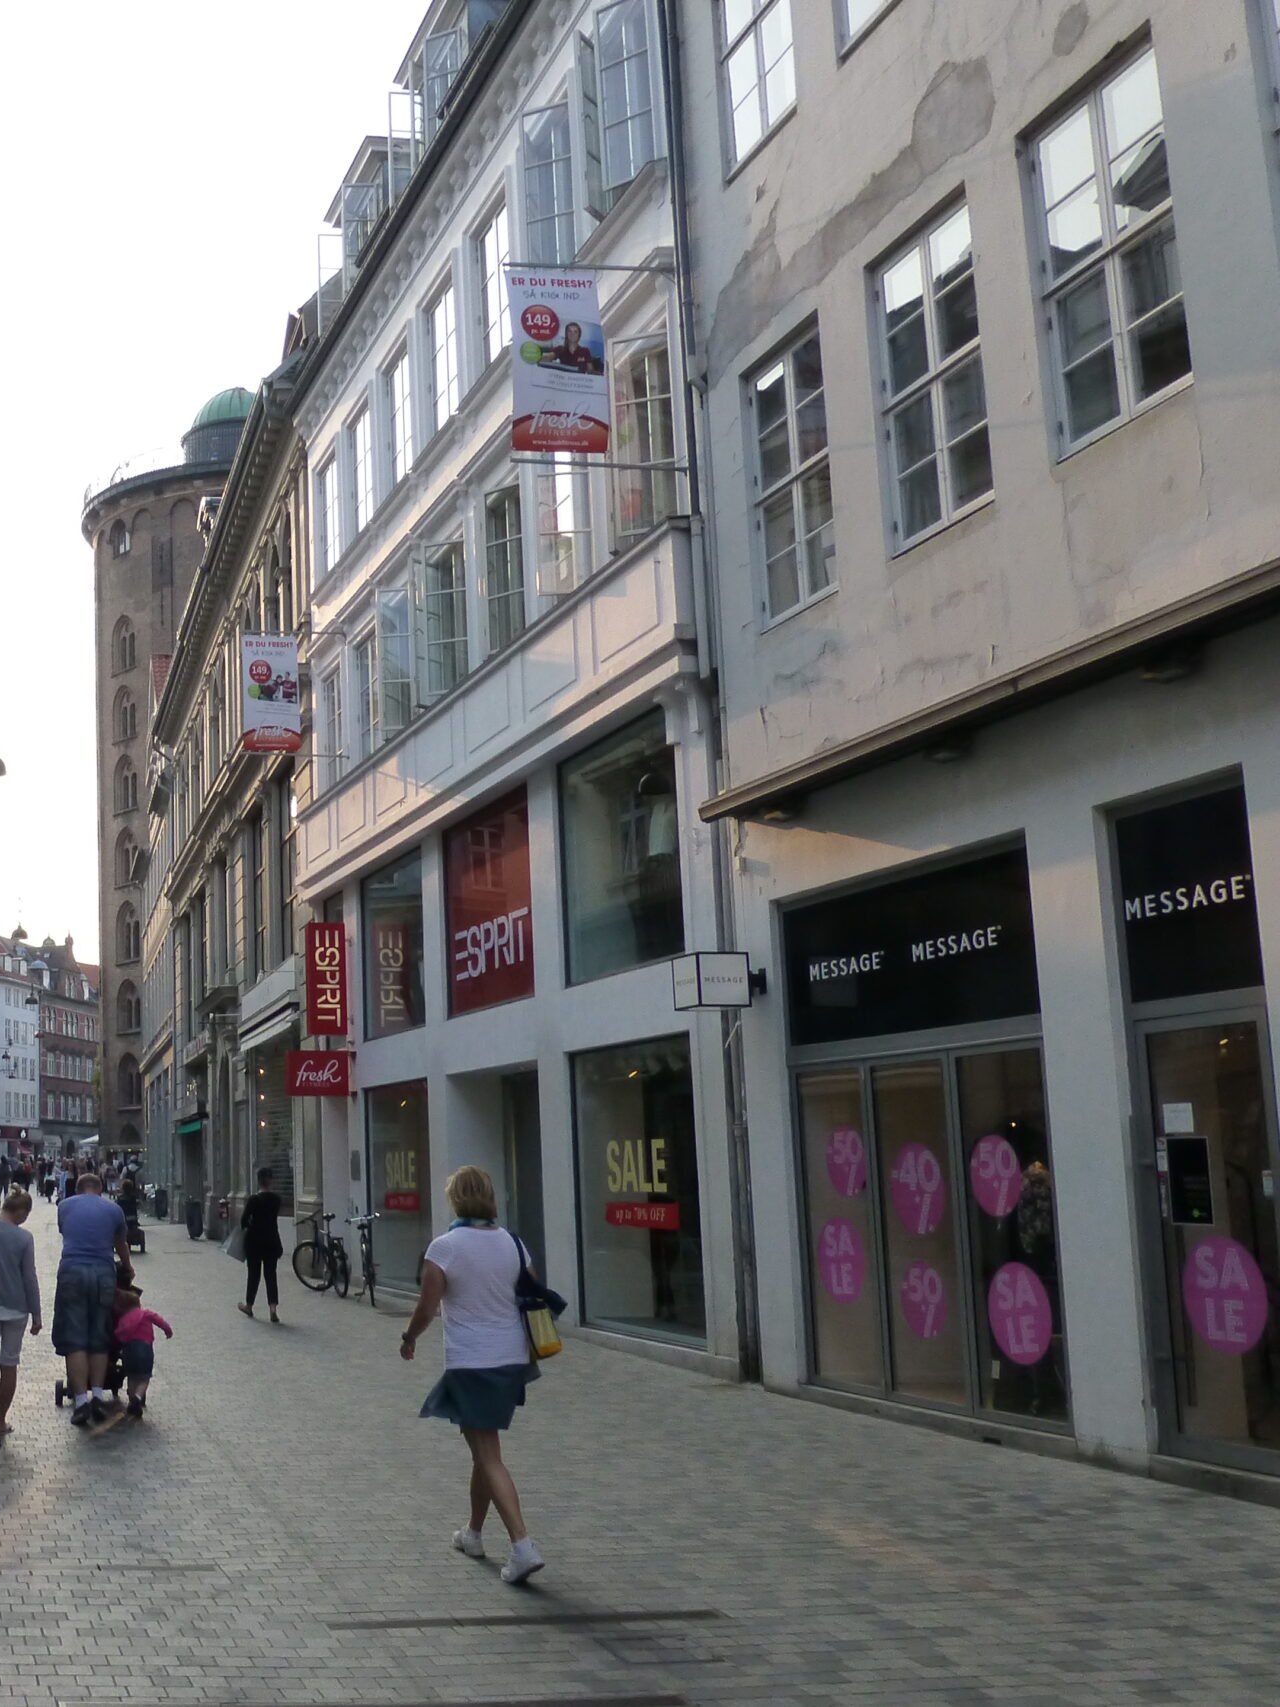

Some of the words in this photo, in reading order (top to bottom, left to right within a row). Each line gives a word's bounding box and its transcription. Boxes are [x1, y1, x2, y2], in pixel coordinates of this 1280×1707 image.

[511, 277, 526, 286] ER
[530, 278, 546, 287] DU
[551, 279, 593, 289] FRESH?
[529, 400, 596, 435] fresh
[455, 906, 528, 981] ESPRIT
[315, 930, 341, 1028] ESPRIT
[703, 976, 744, 984] MESSAGE
[296, 1059, 342, 1087] fresh
[385, 1151, 417, 1189] SALE
[606, 1138, 668, 1193] SALE
[650, 1207, 666, 1222] OFF
